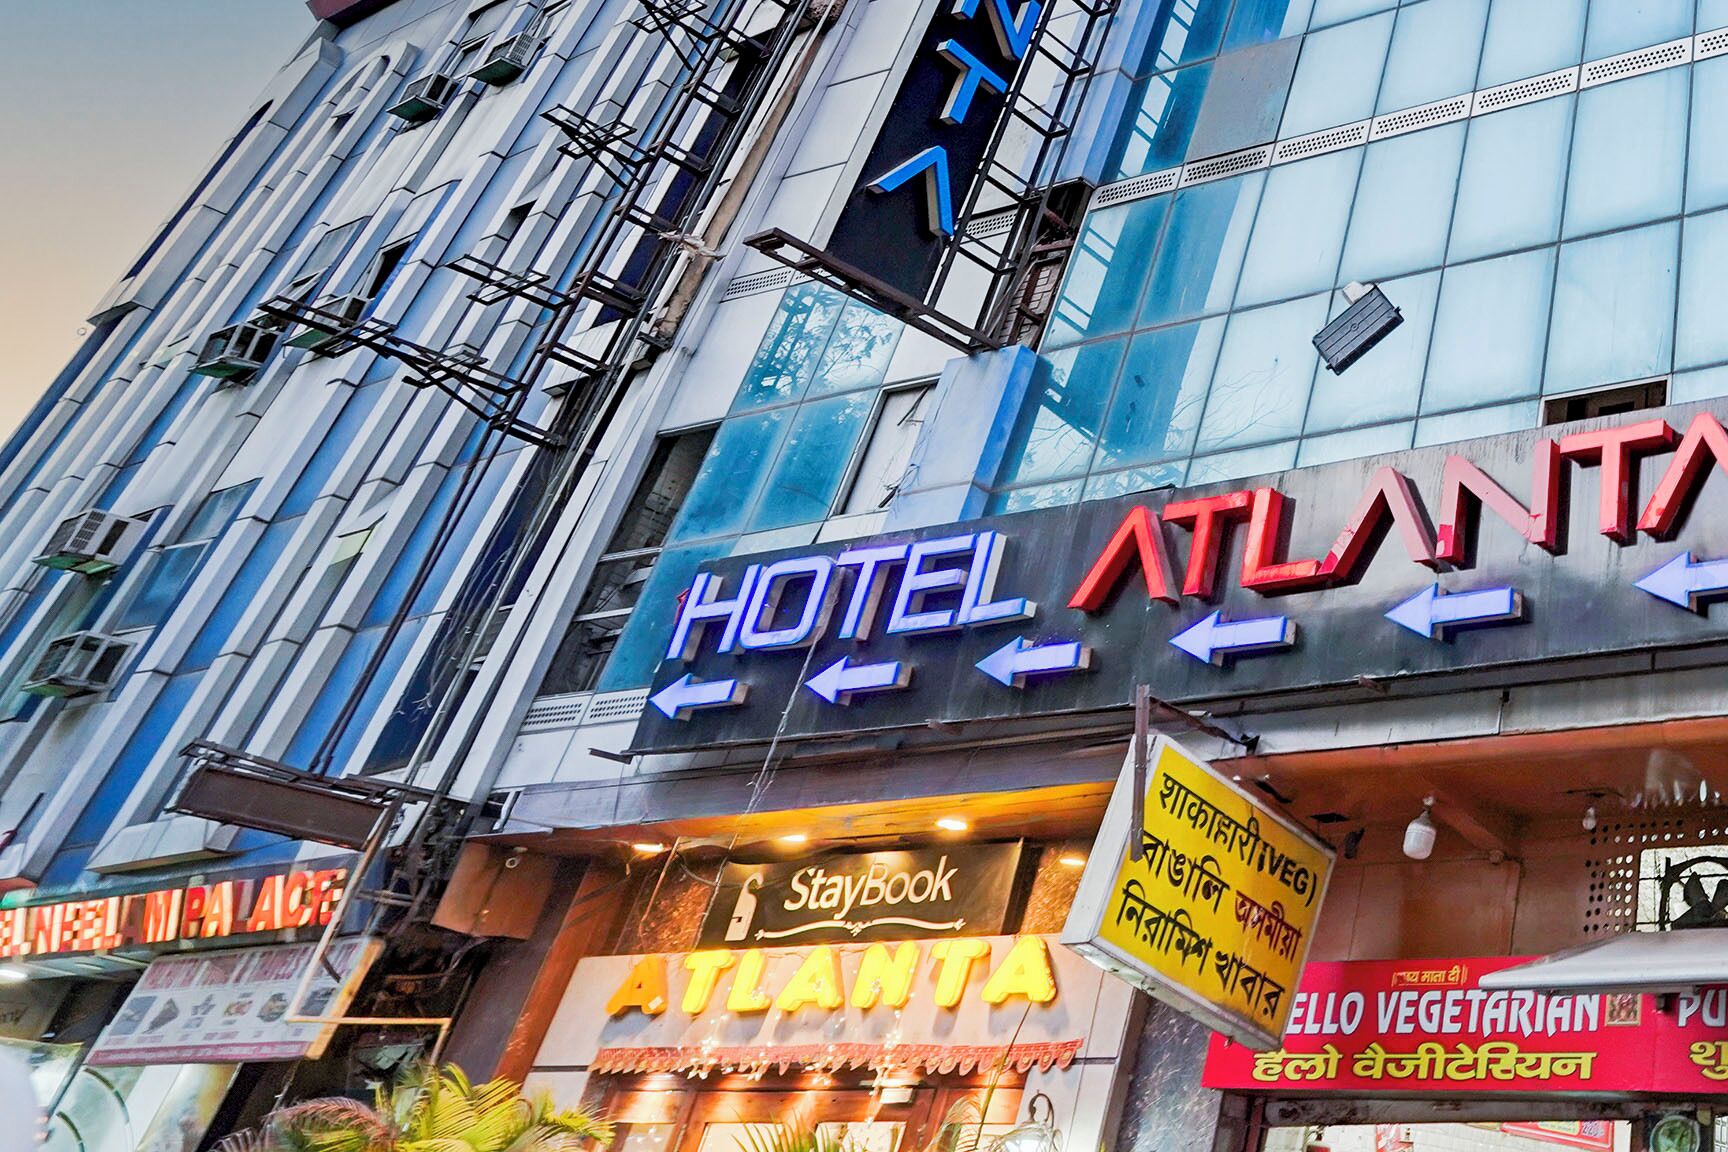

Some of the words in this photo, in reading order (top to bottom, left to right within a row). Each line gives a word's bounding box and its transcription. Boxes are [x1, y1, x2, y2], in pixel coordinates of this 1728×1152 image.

[666, 529, 1034, 662] HOTEL
[182, 869, 348, 939] PALACE
[783, 855, 959, 920] StayBook
[604, 935, 1057, 1016] ATLANTA
[1377, 988, 1600, 1038] VEGETARIAN
